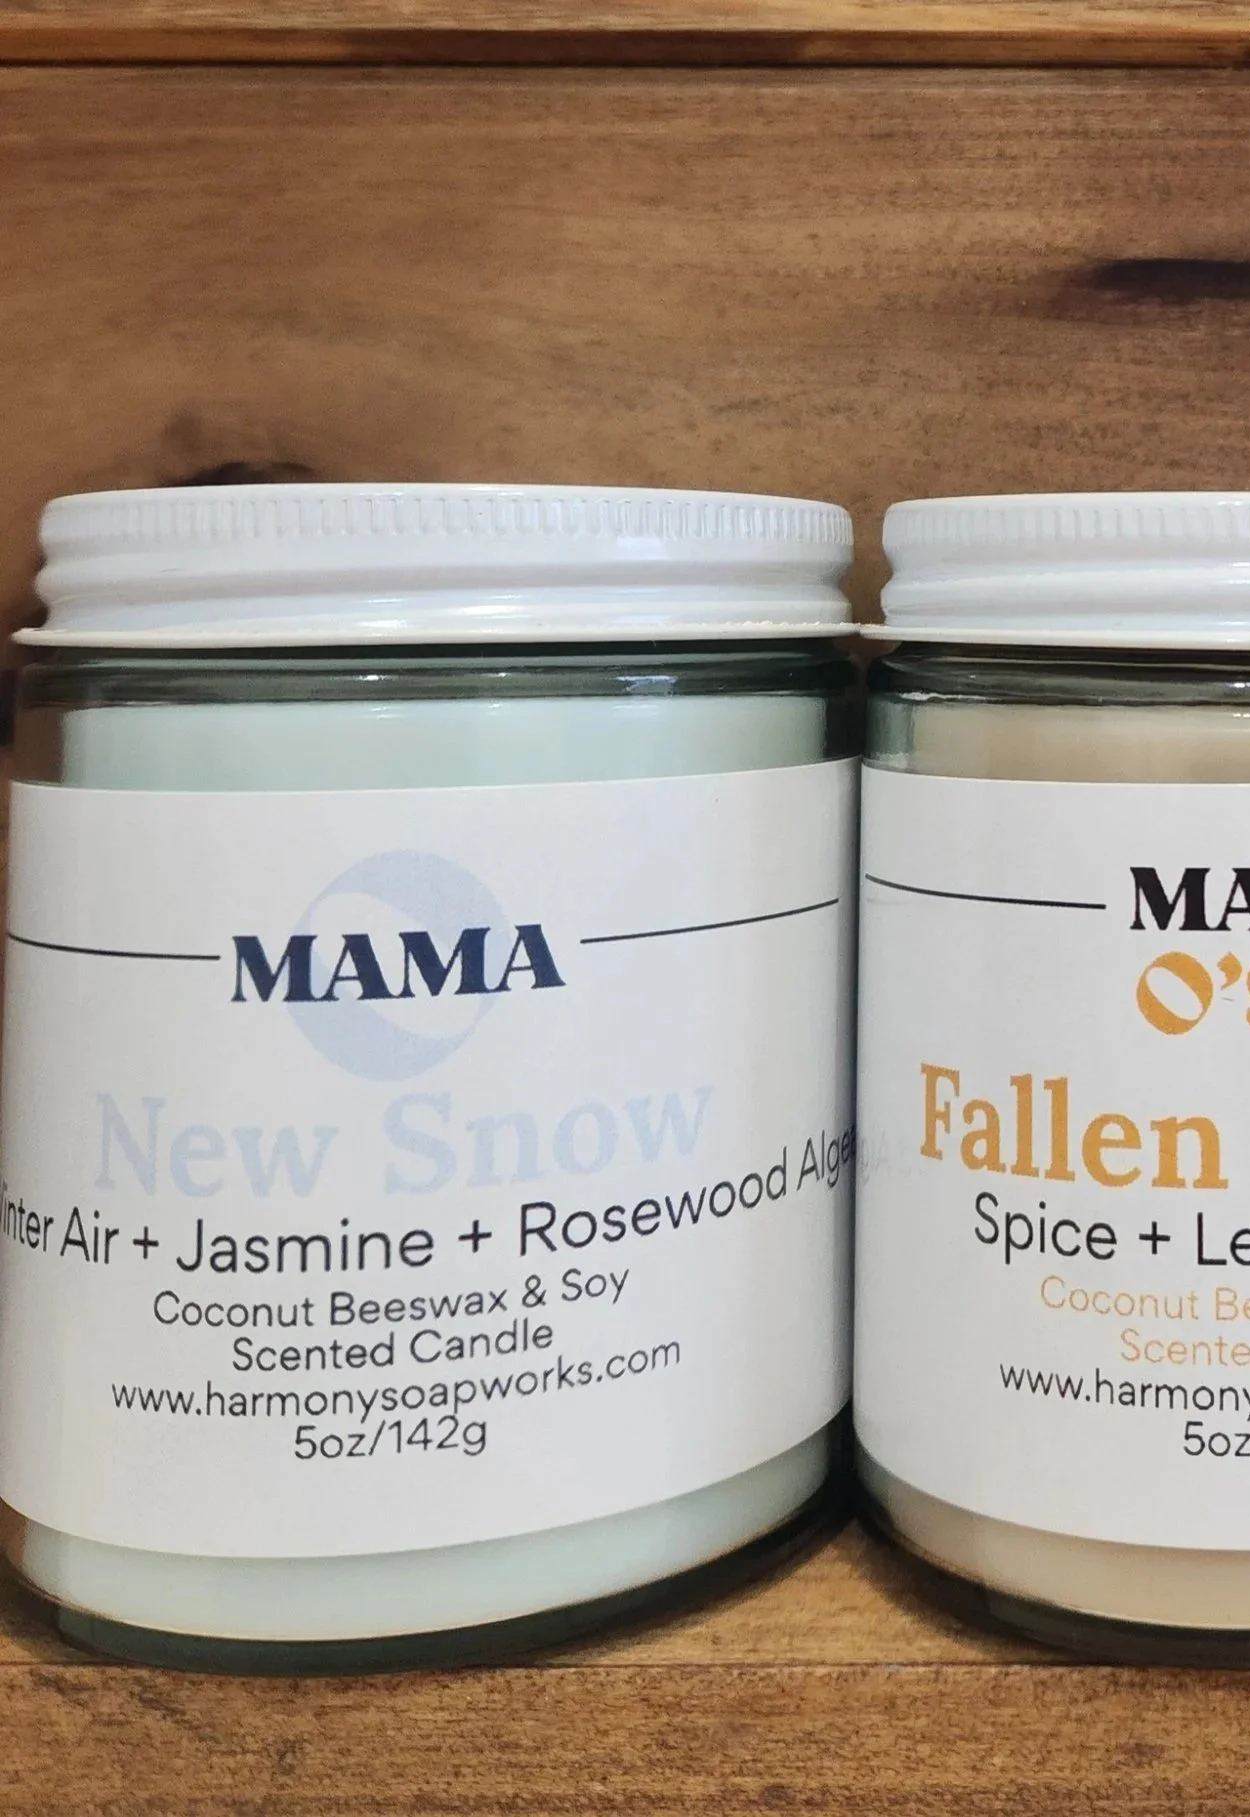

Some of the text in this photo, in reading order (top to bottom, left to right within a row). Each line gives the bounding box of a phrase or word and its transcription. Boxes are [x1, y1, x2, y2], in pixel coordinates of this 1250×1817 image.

[231, 924, 567, 1004] MAMA
[95, 1085, 716, 1199] New Snow
[920, 1063, 1229, 1190] Fallen
[0, 1179, 54, 1253] inter
[60, 1206, 120, 1264] Air
[133, 1226, 159, 1260] +
[176, 1217, 435, 1274] Jasmine
[458, 1219, 492, 1254] +
[519, 1146, 787, 1257] Rosewood
[974, 1192, 1118, 1266] Spice
[154, 1267, 630, 1329] Coconut Beeswax & Soy
[1041, 1275, 1199, 1321] Coconut
[112, 1341, 681, 1425] www.harmonysoapworks.com
[232, 1317, 554, 1373] Scented Candle
[294, 1417, 487, 1461] 5oz/142g
